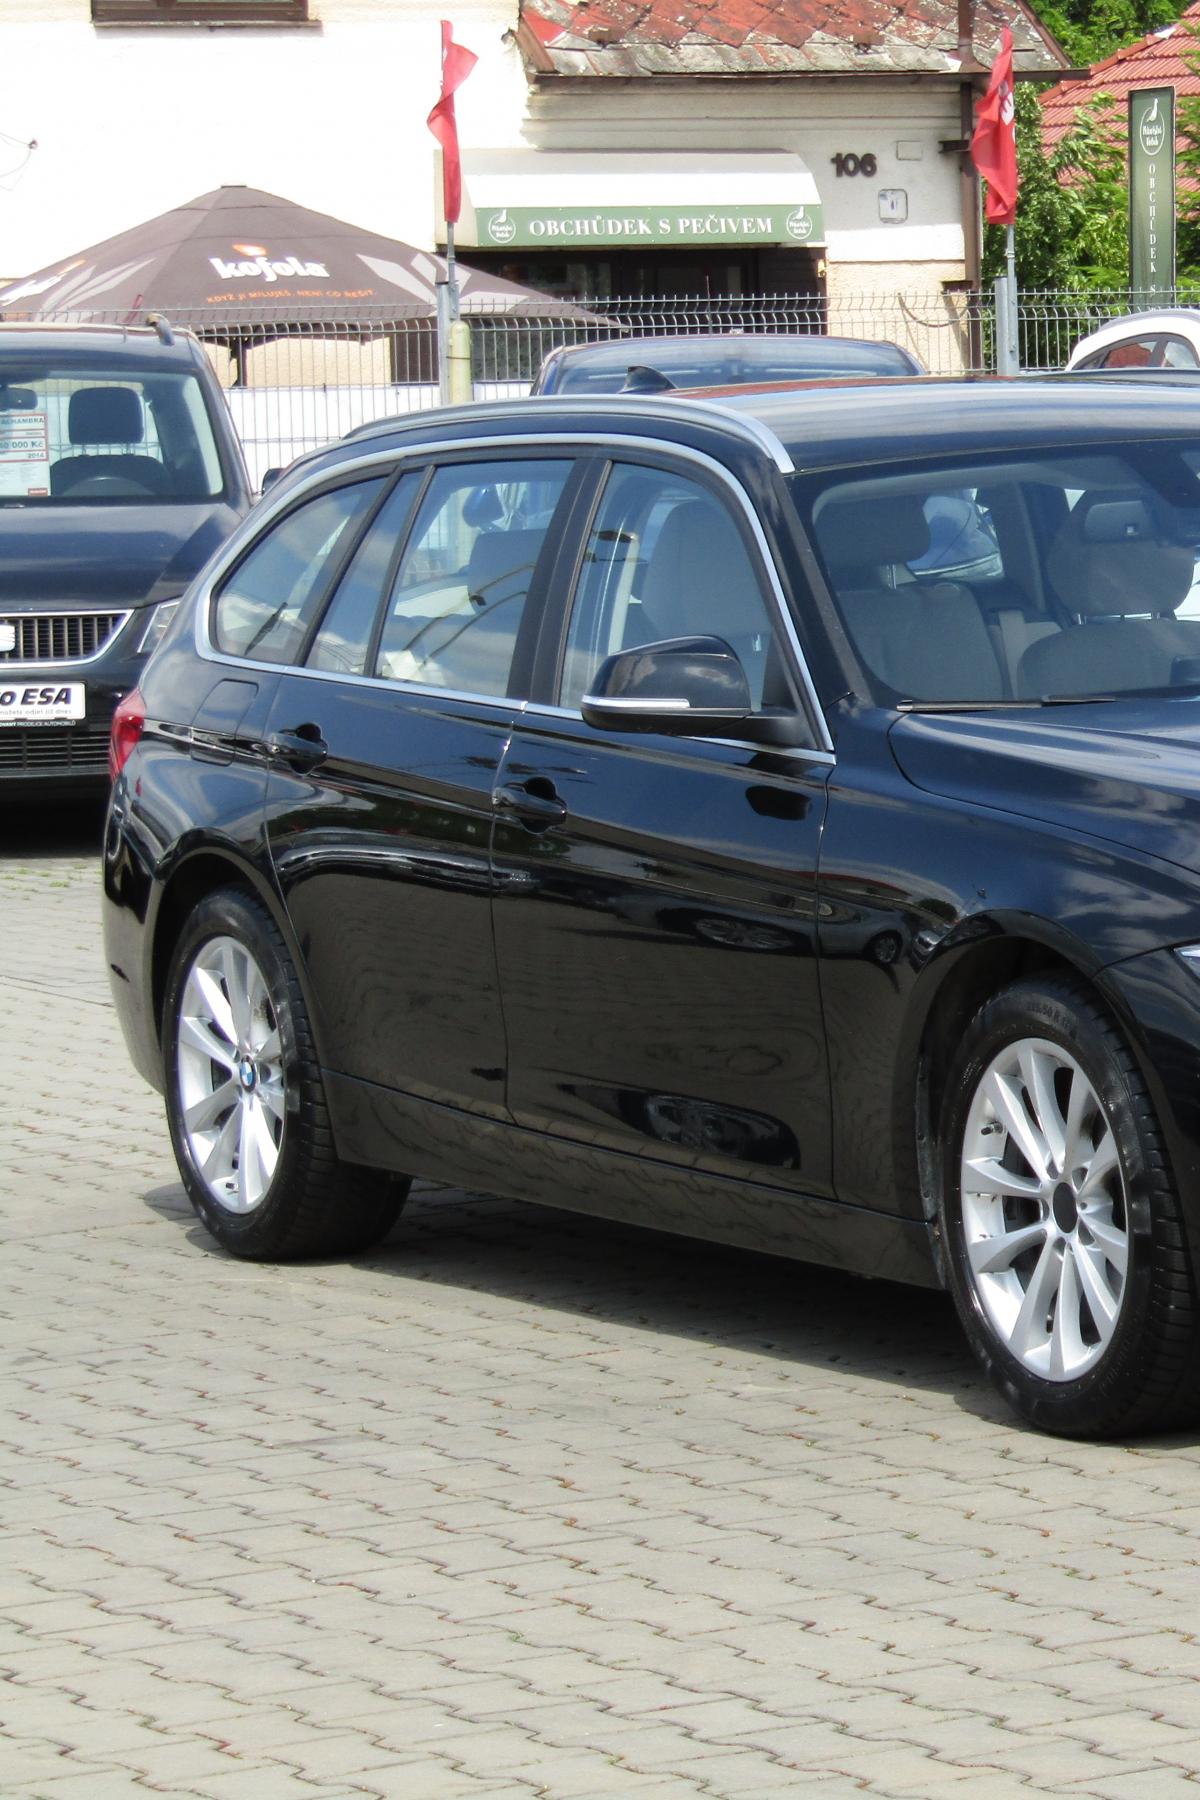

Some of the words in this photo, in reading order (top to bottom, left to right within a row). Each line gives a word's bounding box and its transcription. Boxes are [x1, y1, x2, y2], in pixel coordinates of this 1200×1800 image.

[830, 152, 877, 178] 106
[529, 215, 652, 237] OBCHŮDEK
[658, 218, 671, 235] S
[678, 214, 773, 235] PEČIVEM
[208, 256, 330, 282] kofola
[20, 687, 72, 706] ESA
